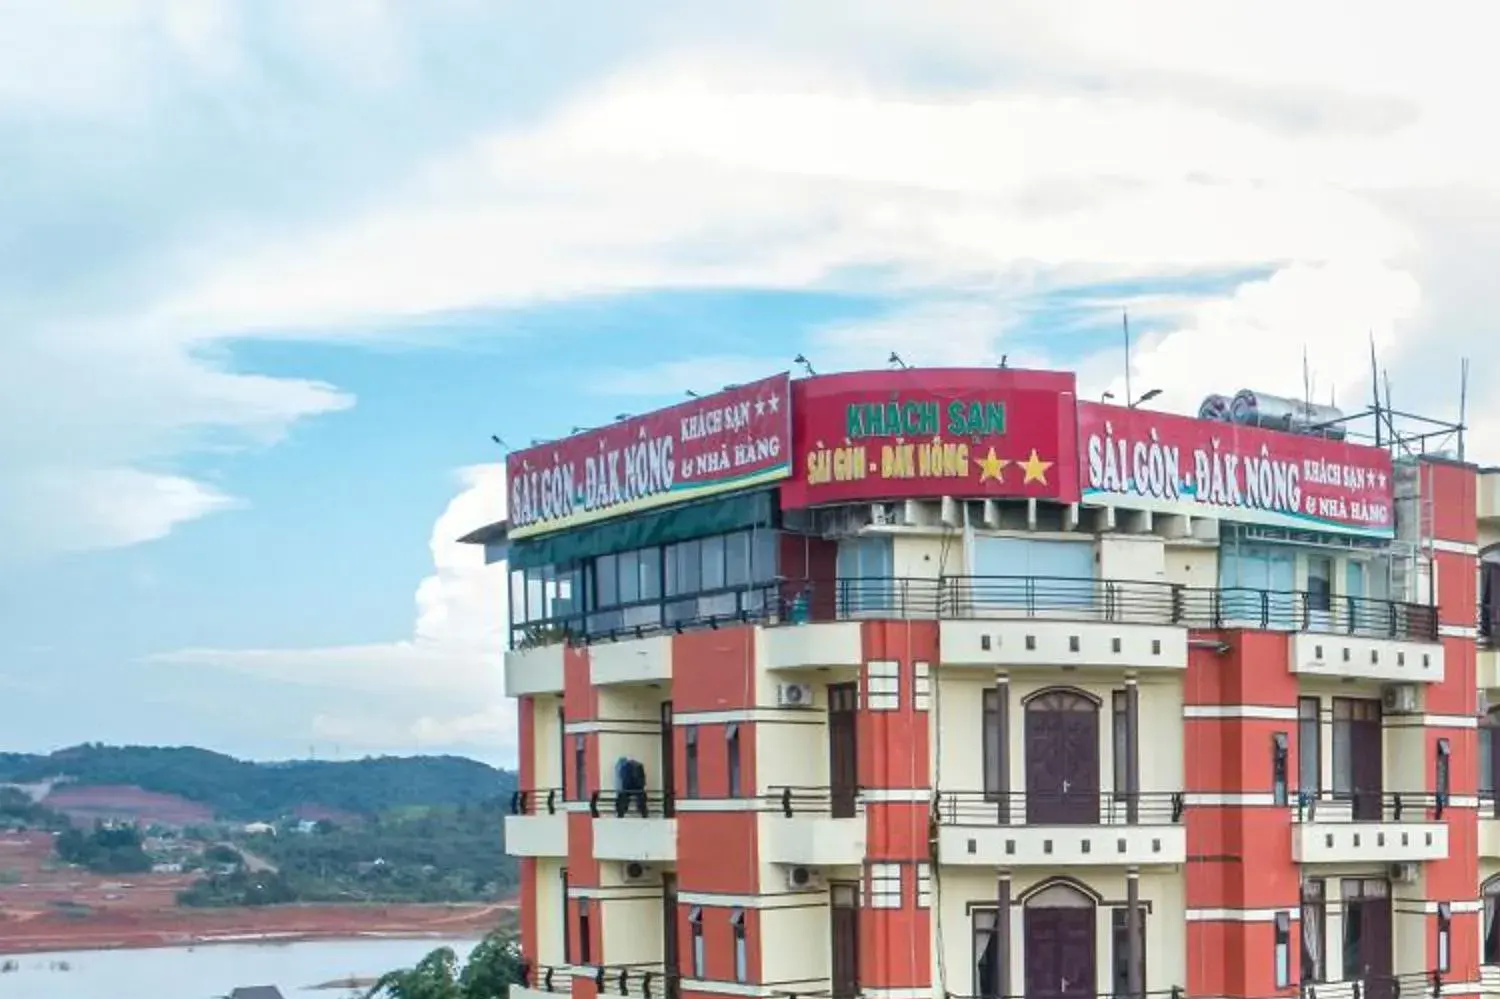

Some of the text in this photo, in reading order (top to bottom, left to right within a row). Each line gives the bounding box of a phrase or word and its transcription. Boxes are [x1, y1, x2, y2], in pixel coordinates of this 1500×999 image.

[681, 401, 750, 442] KHÁCH SẠN
[847, 393, 1006, 443] KHÁCH SẠN
[696, 444, 730, 475] NHÀ
[735, 435, 780, 466] HÀNG
[919, 436, 969, 476] NÔNG
[1087, 420, 1128, 493] SÀI
[1133, 428, 1179, 498] GÒN
[1194, 436, 1240, 506] ĐĂK
[1244, 445, 1300, 512] NÔNG
[512, 460, 538, 527] SÀI
[540, 452, 575, 519] GÒN
[625, 426, 674, 500] NÔNG
[1319, 496, 1348, 518] NHÀ
[1350, 497, 1388, 524] HÀNG
